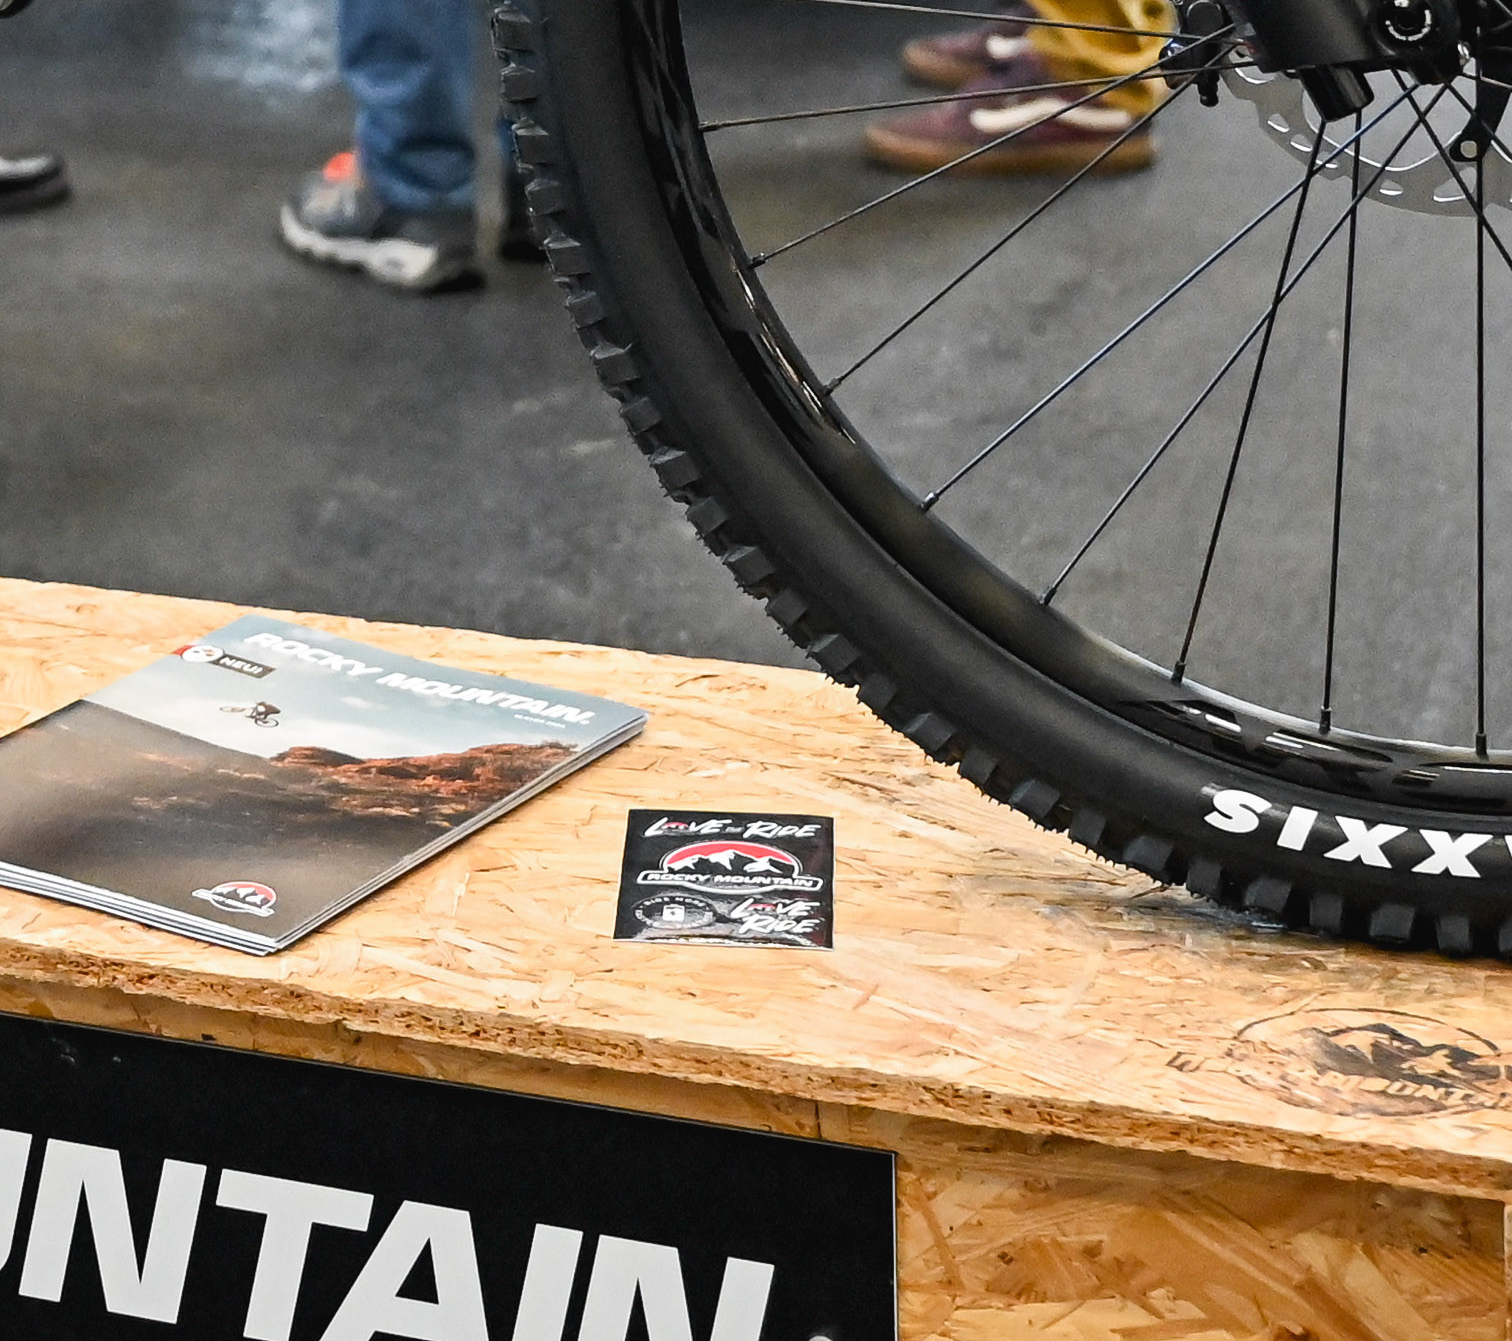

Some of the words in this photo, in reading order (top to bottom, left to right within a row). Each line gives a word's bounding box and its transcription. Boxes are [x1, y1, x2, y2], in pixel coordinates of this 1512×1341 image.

[243, 631, 383, 678] ROCKY
[743, 820, 822, 839] RIDE
[646, 873, 710, 883] ROCKY
[713, 874, 815, 888] MOUNTAIN
[738, 916, 821, 935] RIDE
